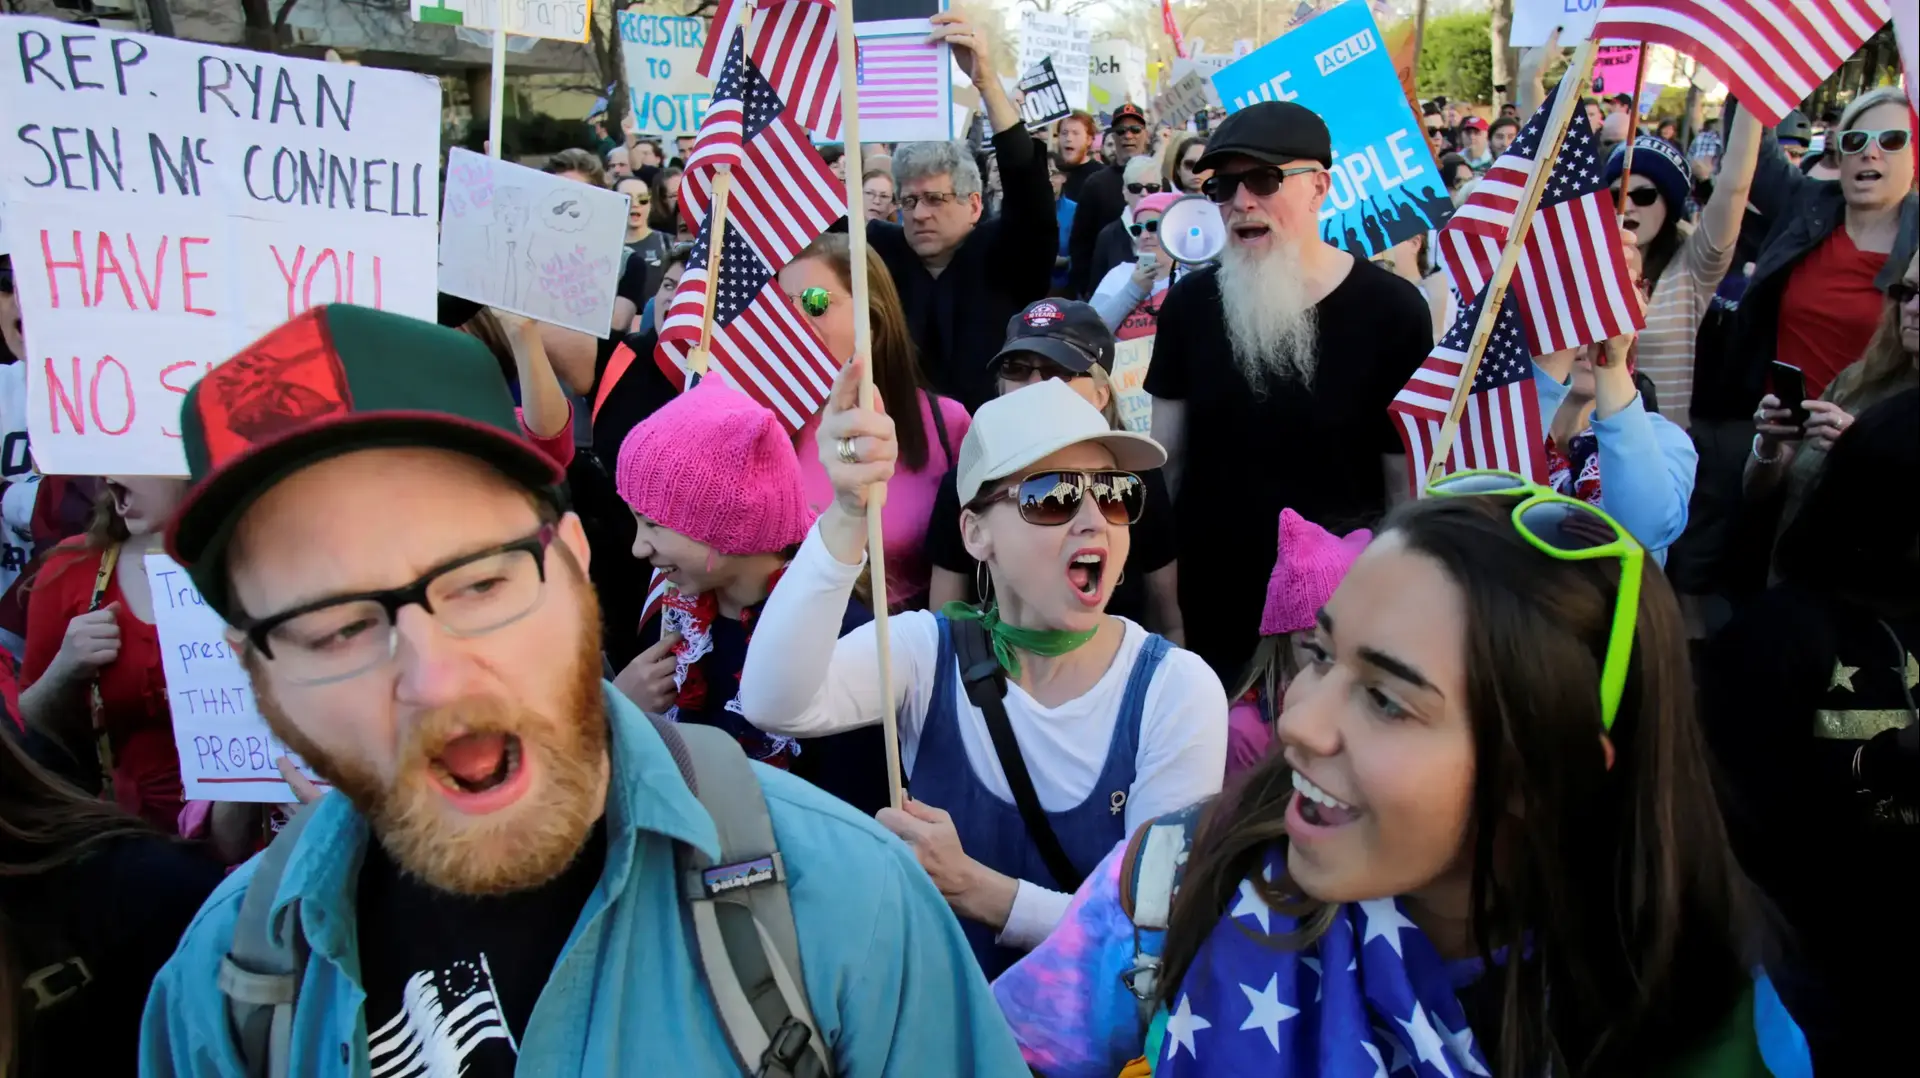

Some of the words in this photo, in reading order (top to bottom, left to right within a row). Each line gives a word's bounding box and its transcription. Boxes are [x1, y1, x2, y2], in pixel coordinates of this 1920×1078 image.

[616, 9, 704, 48] REGISTER
[645, 57, 671, 79] TO
[1320, 33, 1372, 72] ACLU
[17, 30, 158, 97] REP.
[197, 55, 356, 131] RYAN
[629, 86, 712, 132] VOTE
[17, 122, 138, 194] SEN.
[243, 143, 429, 218] CONNELL
[1318, 128, 1425, 222] OPLE
[40, 229, 217, 317] HAVE
[269, 244, 382, 321] YOU
[45, 355, 136, 437] NO
[159, 360, 213, 439] S
[156, 571, 204, 609] Tru
[178, 640, 234, 674] presi
[179, 687, 246, 715] THAT
